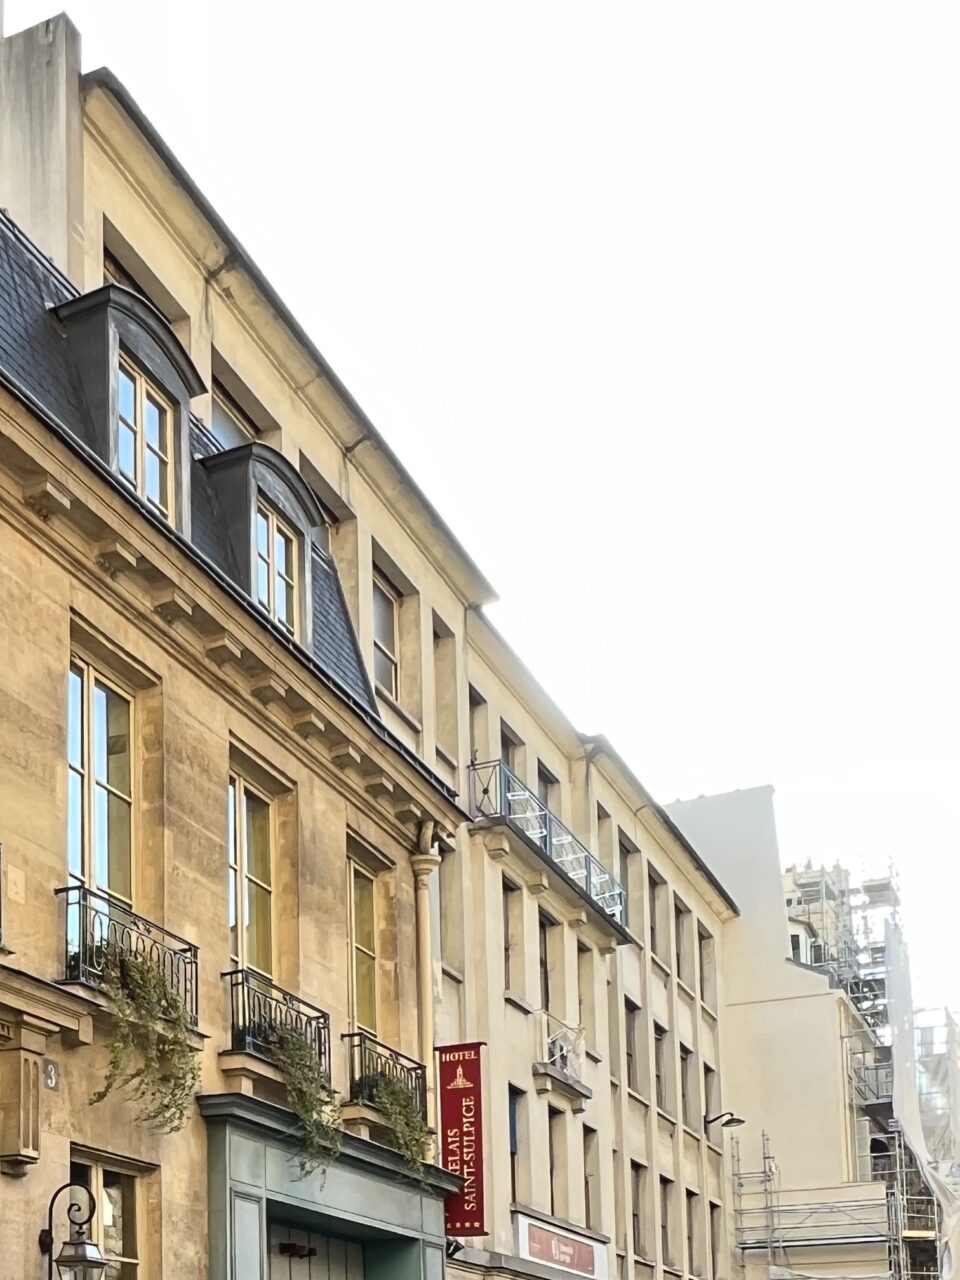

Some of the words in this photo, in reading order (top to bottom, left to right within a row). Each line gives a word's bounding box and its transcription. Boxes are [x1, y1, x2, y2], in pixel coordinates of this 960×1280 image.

[441, 1050, 478, 1062] HOTEL
[47, 1064, 56, 1088] 3
[462, 1096, 477, 1211] SAINT-SULPICE
